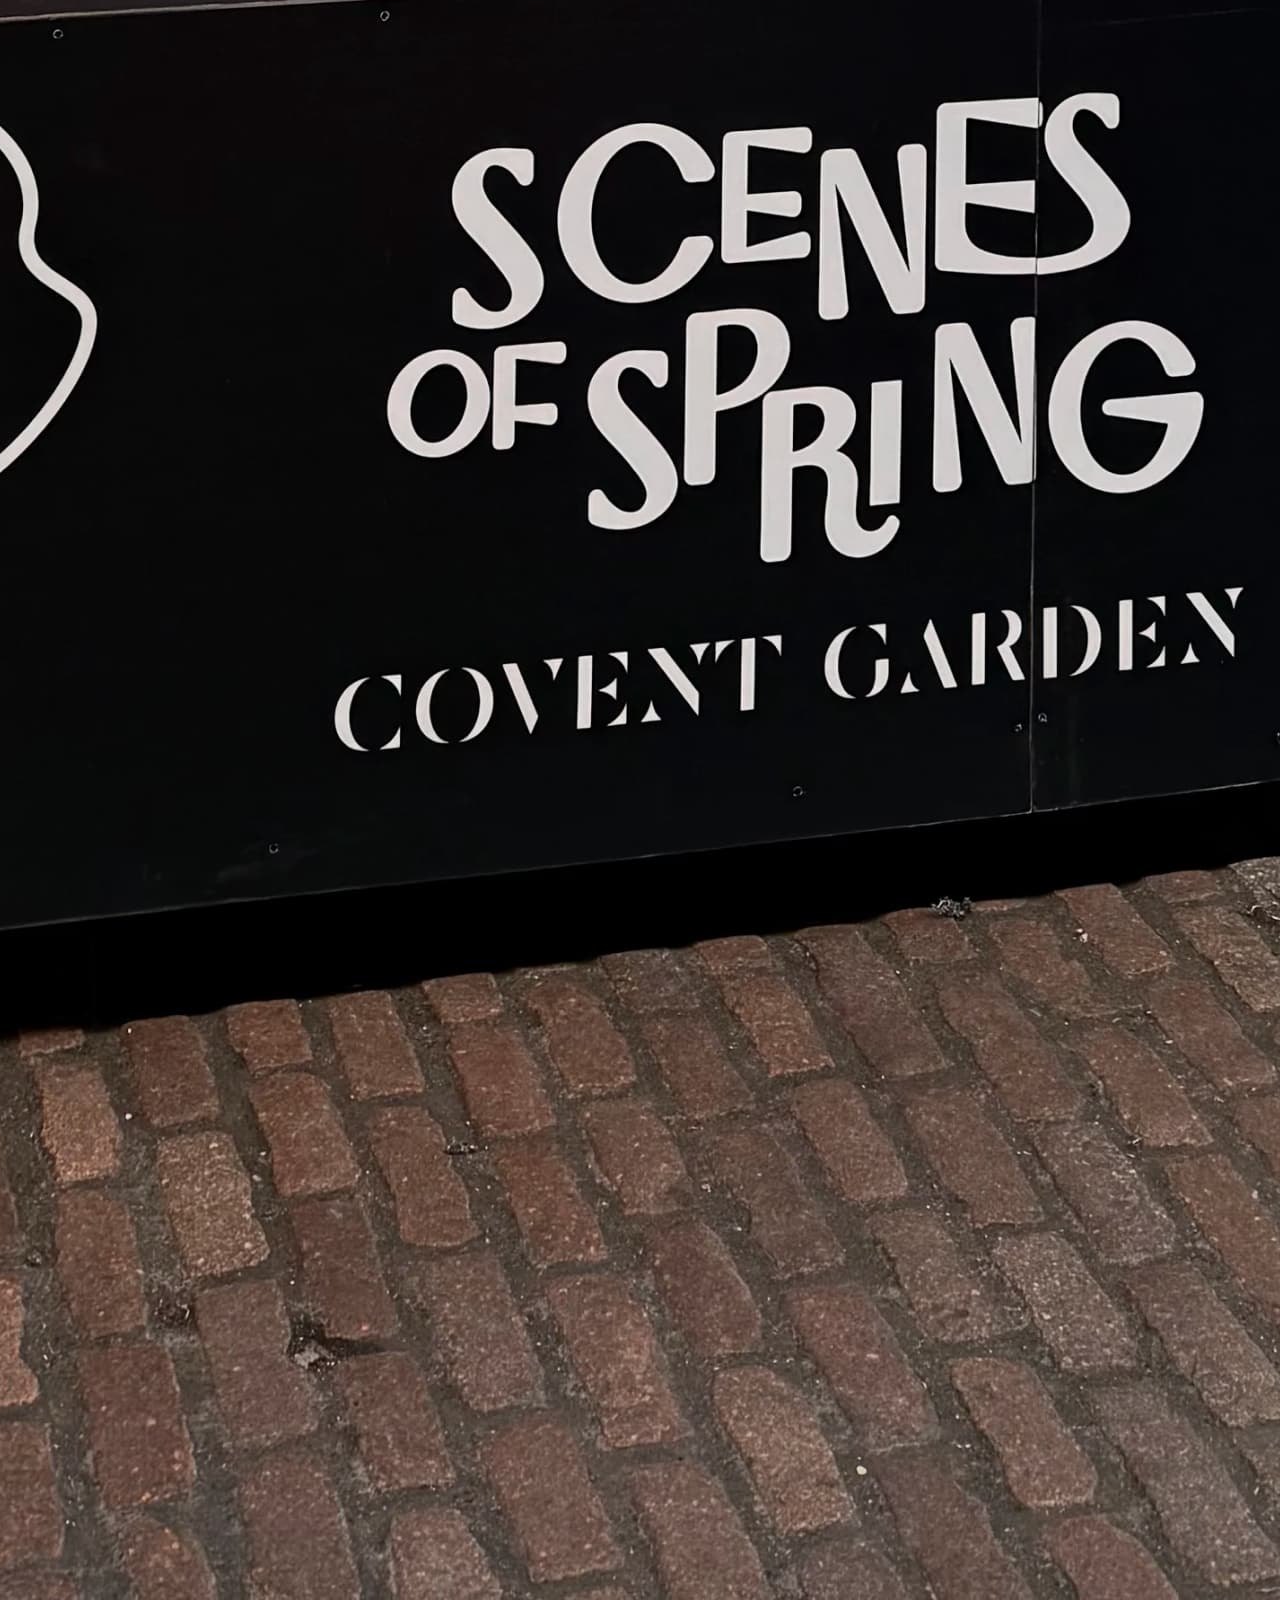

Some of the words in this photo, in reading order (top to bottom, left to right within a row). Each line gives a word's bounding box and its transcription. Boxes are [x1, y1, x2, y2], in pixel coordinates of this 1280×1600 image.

[450, 91, 1132, 331] SCENES
[385, 340, 568, 459] OF
[586, 307, 1206, 564] SPRING
[333, 633, 783, 753] COVENT
[822, 586, 1245, 700] GARDEN
